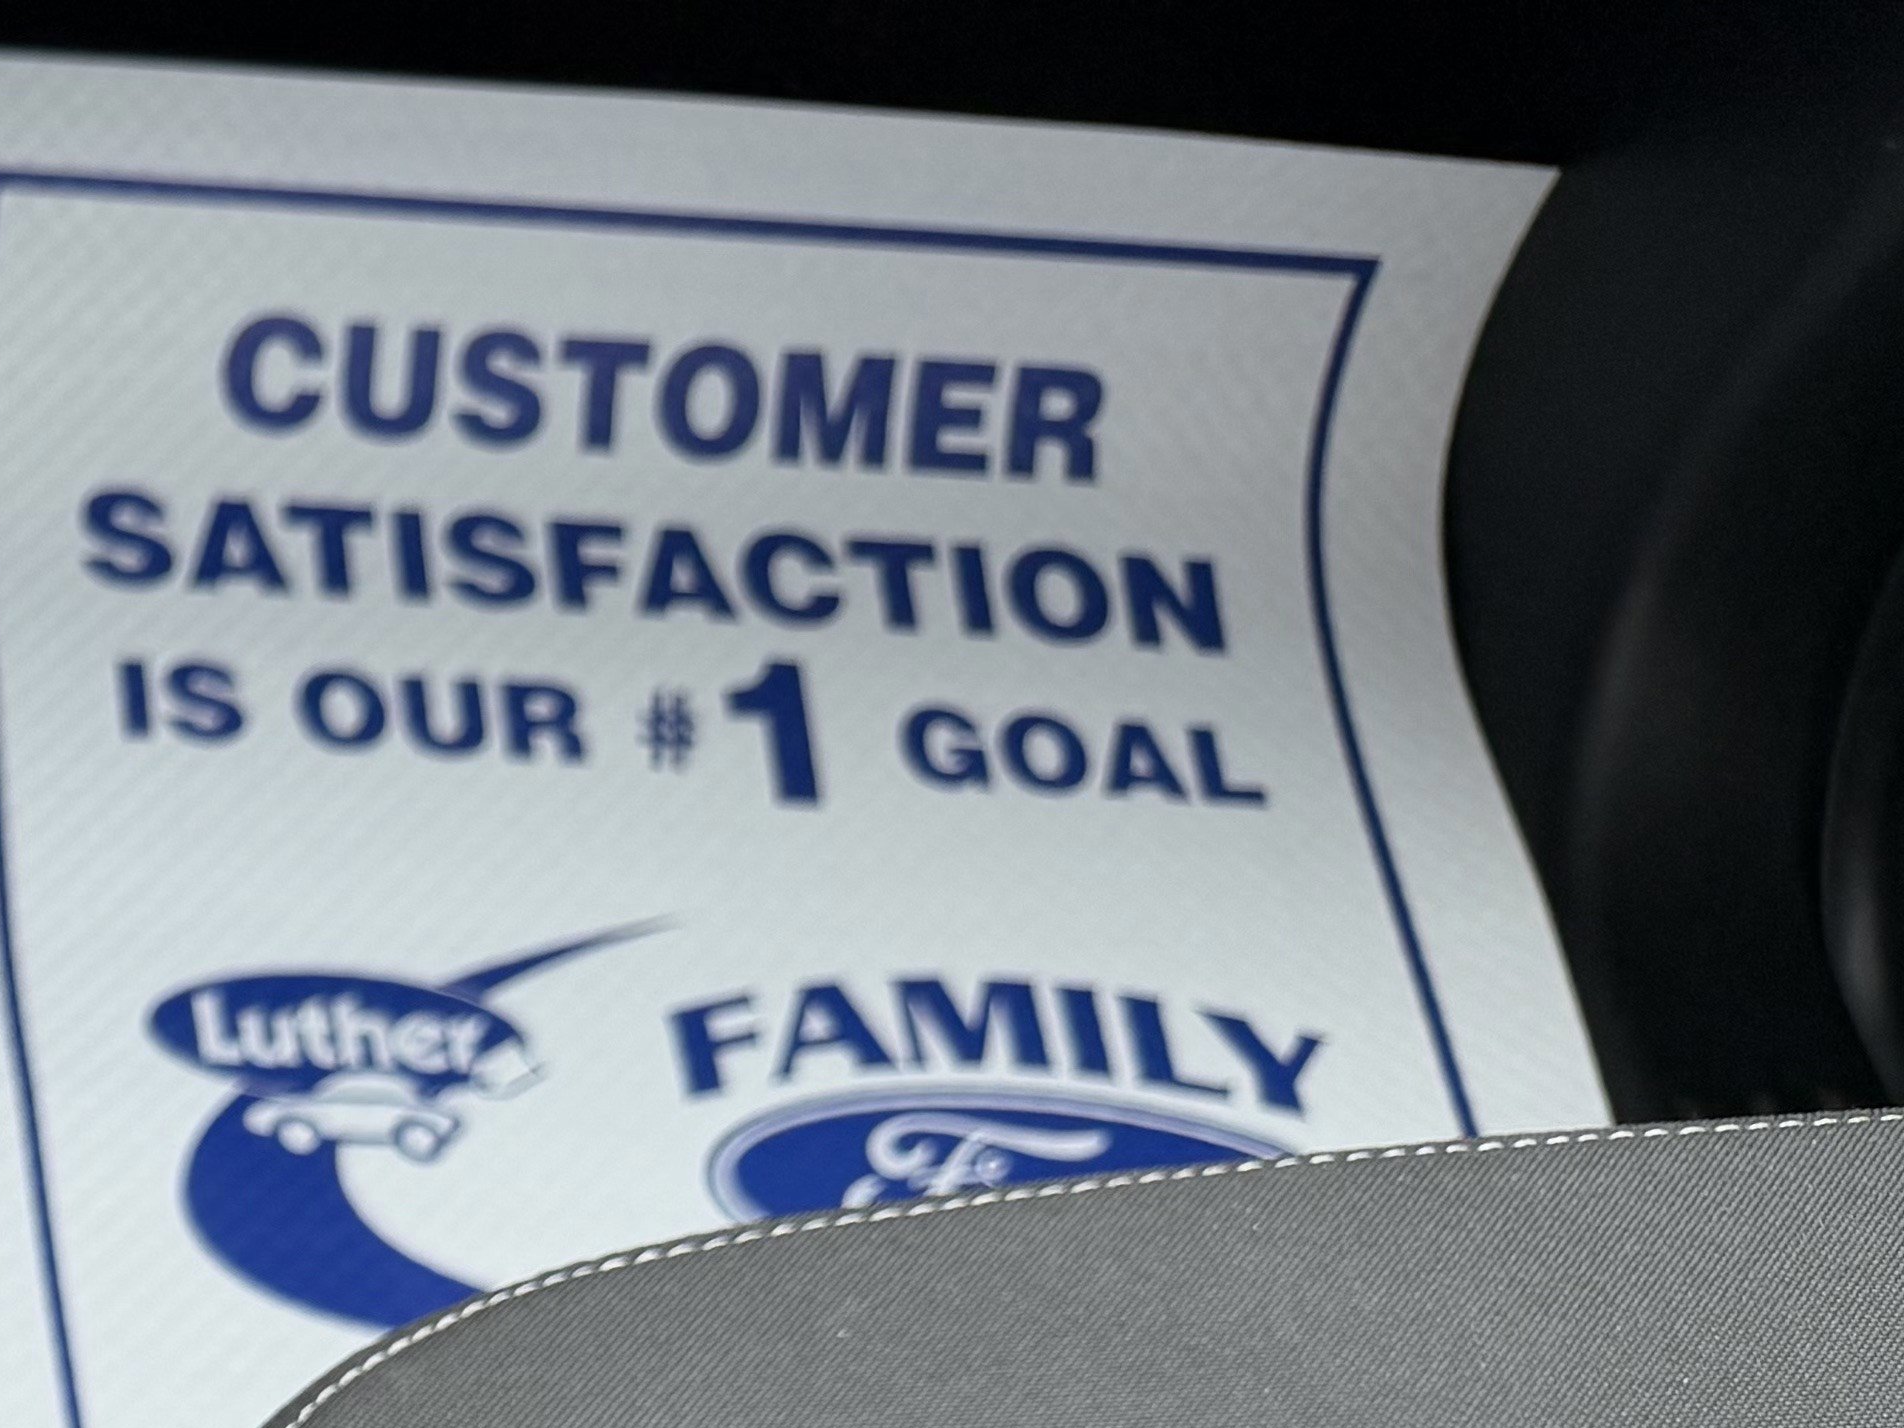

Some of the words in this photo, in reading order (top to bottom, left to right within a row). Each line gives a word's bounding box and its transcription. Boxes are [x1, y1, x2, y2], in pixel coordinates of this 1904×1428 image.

[220, 313, 1108, 488] CUSTOMER
[80, 487, 1231, 658] SATISFACTION
[117, 657, 246, 743] IS
[295, 666, 588, 763] OUR
[898, 703, 1270, 808] GOAL
[191, 991, 494, 1077] Luther
[669, 977, 1323, 1114] FAMILY
